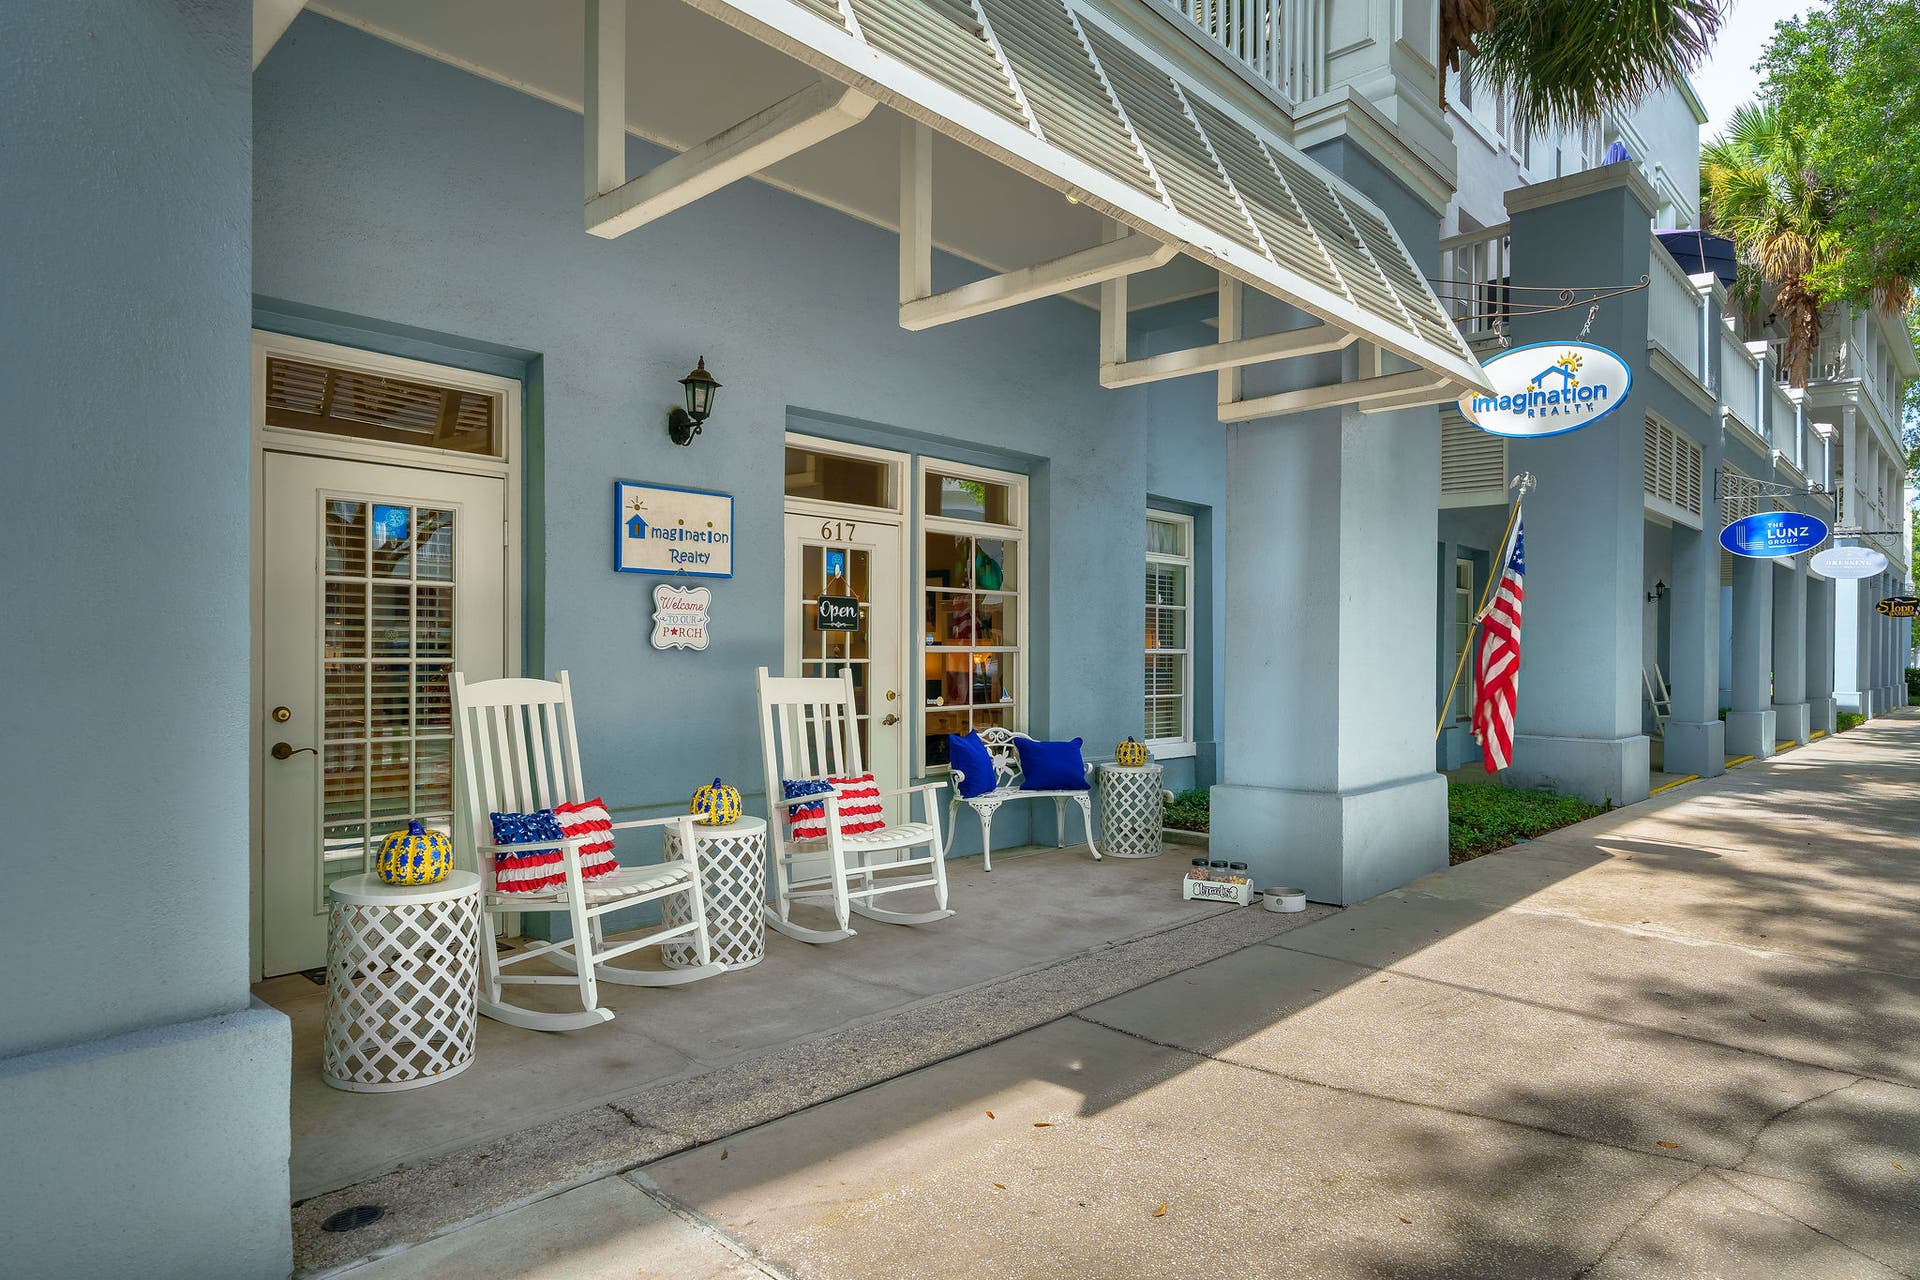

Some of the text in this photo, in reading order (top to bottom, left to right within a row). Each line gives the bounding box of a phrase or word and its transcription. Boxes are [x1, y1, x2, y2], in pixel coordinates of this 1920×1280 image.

[1472, 370, 1608, 415] imagination
[1528, 403, 1593, 419] REALTY
[821, 521, 856, 541] 617
[1767, 526, 1809, 539] LUNZ
[669, 548, 711, 565] Realty
[660, 596, 704, 611] Welcome
[820, 600, 857, 622] Open
[667, 615, 697, 625] TO OUR
